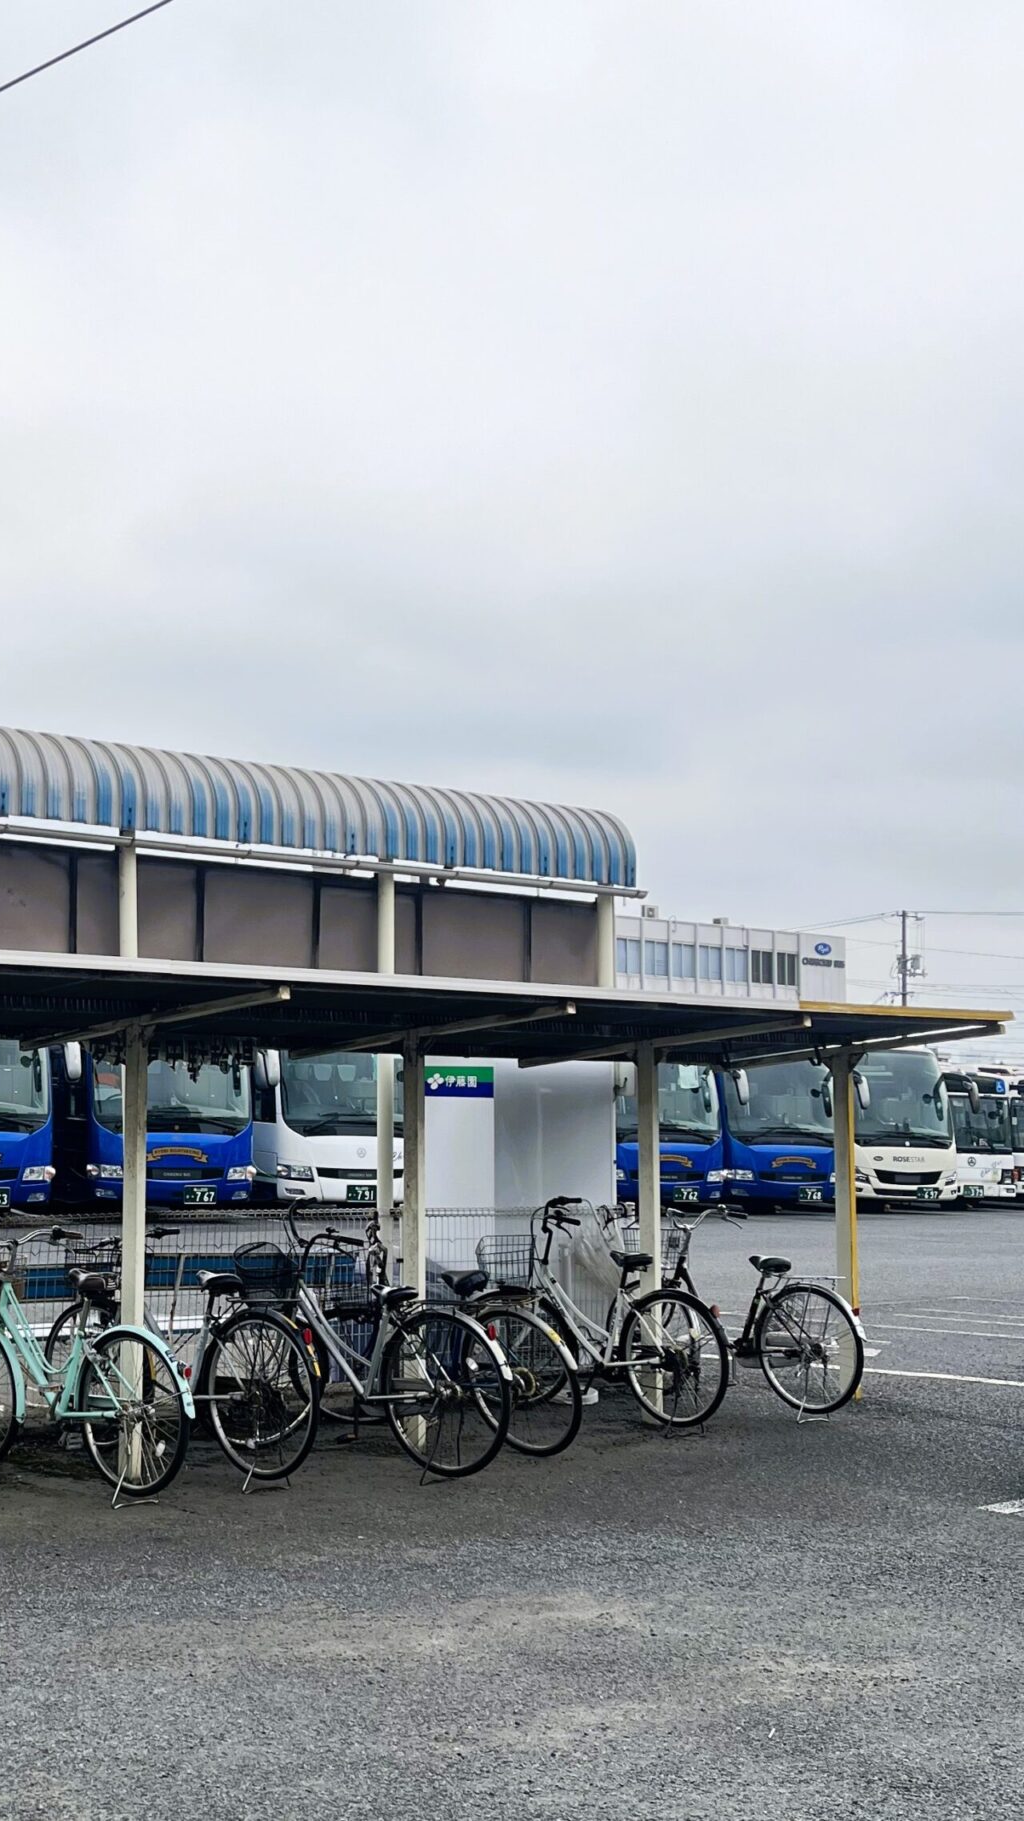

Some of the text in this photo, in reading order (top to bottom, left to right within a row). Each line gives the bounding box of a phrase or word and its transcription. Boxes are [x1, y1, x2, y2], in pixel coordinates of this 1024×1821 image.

[445, 1075, 478, 1089] 伊藤園
[195, 1191, 215, 1202] 767
[357, 1190, 374, 1201] 791
[682, 1191, 698, 1201] 762
